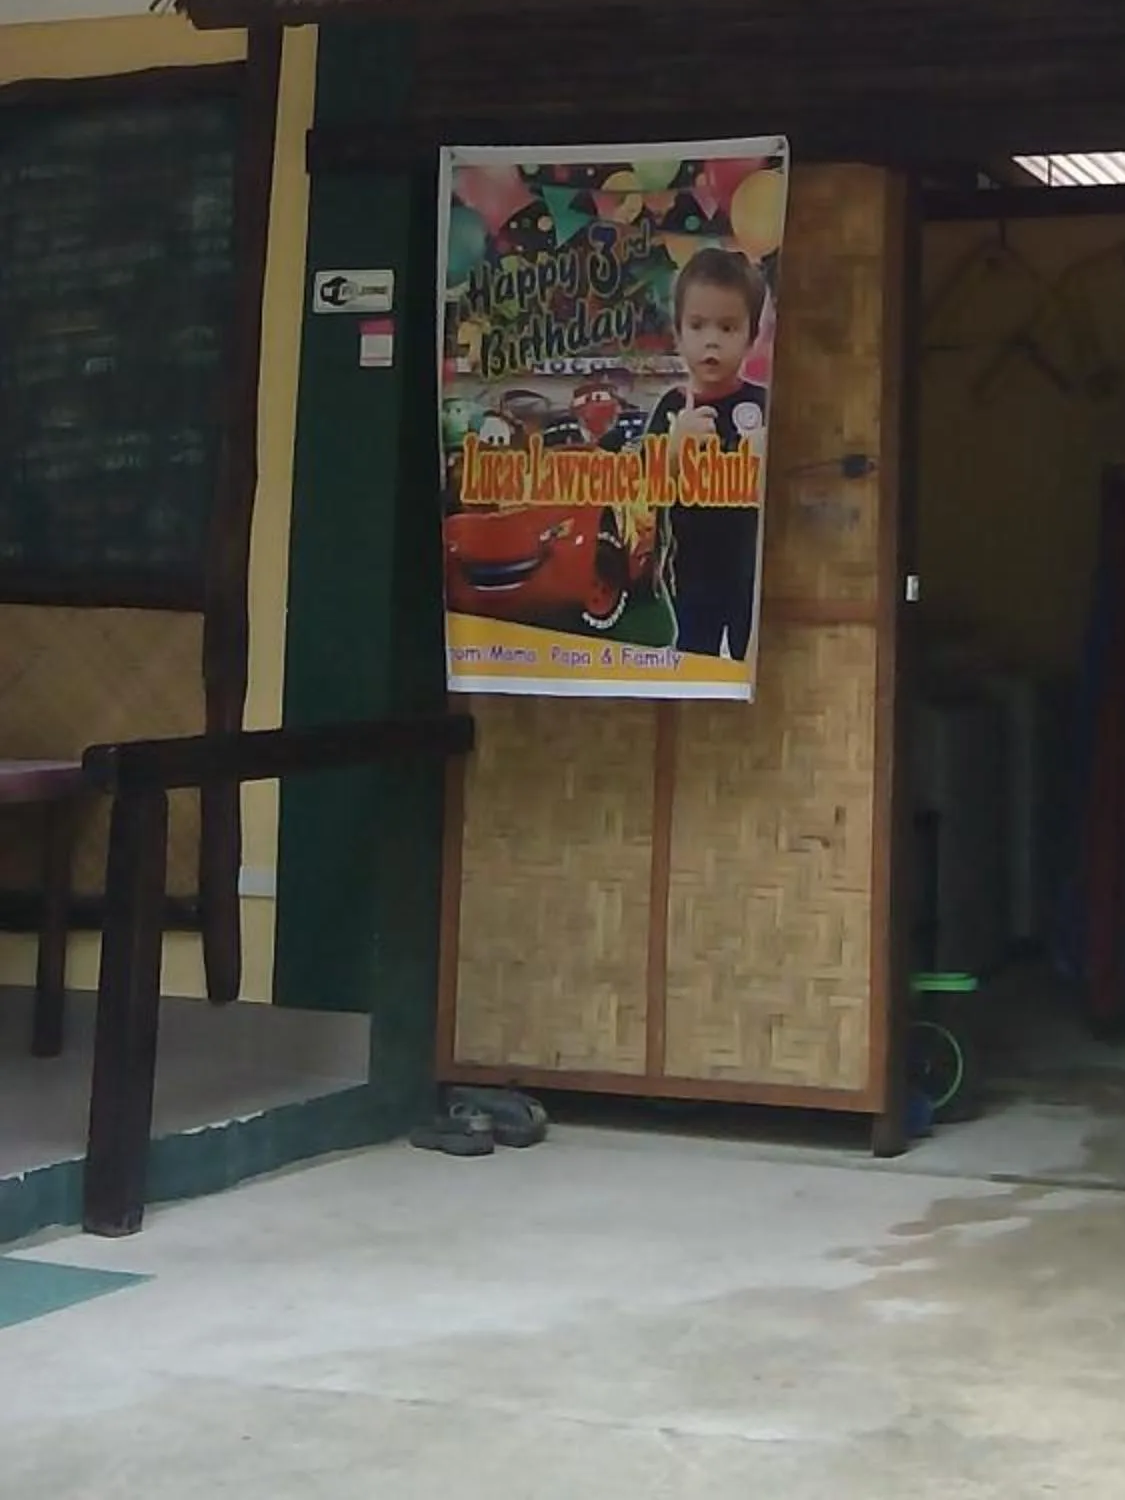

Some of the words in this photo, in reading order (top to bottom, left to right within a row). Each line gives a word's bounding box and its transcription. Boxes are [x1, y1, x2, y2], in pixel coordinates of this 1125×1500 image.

[467, 251, 580, 315] Happy
[587, 220, 651, 297] 3rd
[479, 298, 636, 381] Birthday
[529, 433, 642, 505] Lawrence
[551, 646, 591, 666] Papa
[621, 647, 682, 670] Family
